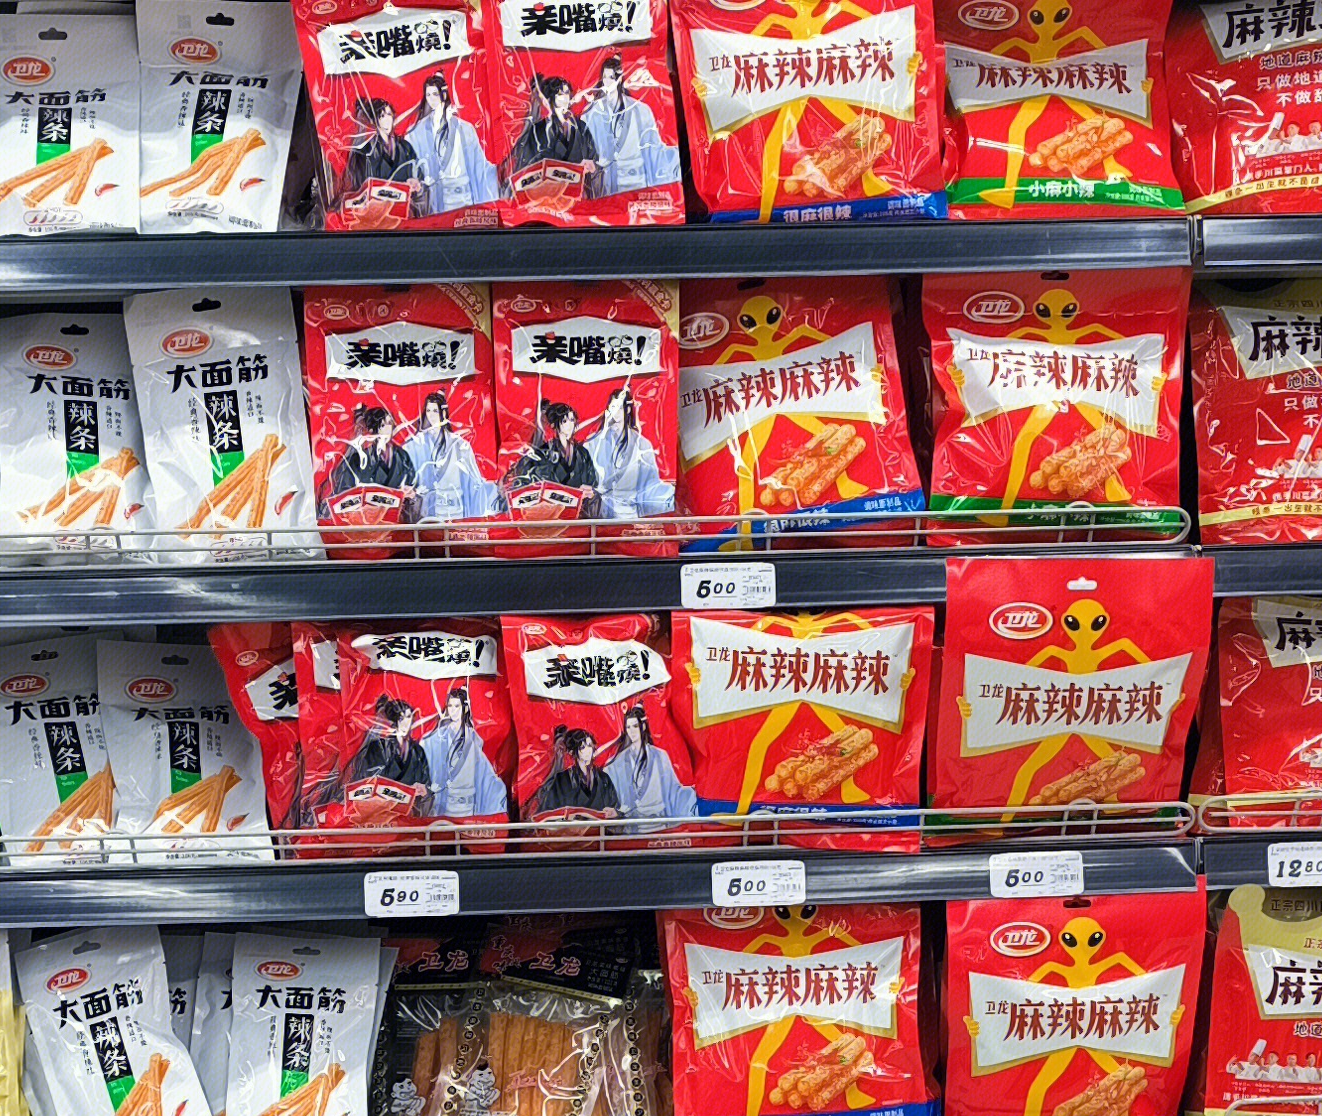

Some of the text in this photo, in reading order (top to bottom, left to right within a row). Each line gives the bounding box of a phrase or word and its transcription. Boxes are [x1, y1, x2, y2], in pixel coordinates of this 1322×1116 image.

[733, 38, 895, 97] 麻辣麻辣
[196, 89, 228, 134] 辣条
[702, 353, 858, 422] 麻辣麻辣
[68, 401, 96, 452] 辣条
[1003, 609, 1039, 630] 卫龙
[726, 647, 891, 694] 麻辣麻辣
[996, 687, 1164, 726] 麻辣麻辣
[48, 722, 82, 774] 辣条
[170, 722, 200, 770] 辣条
[1001, 928, 1040, 949] 卫龙
[723, 962, 880, 1012] 麻辣麻辣
[285, 1013, 311, 1070] 辣条
[1003, 1005, 1162, 1043] 麻辣麻辣
